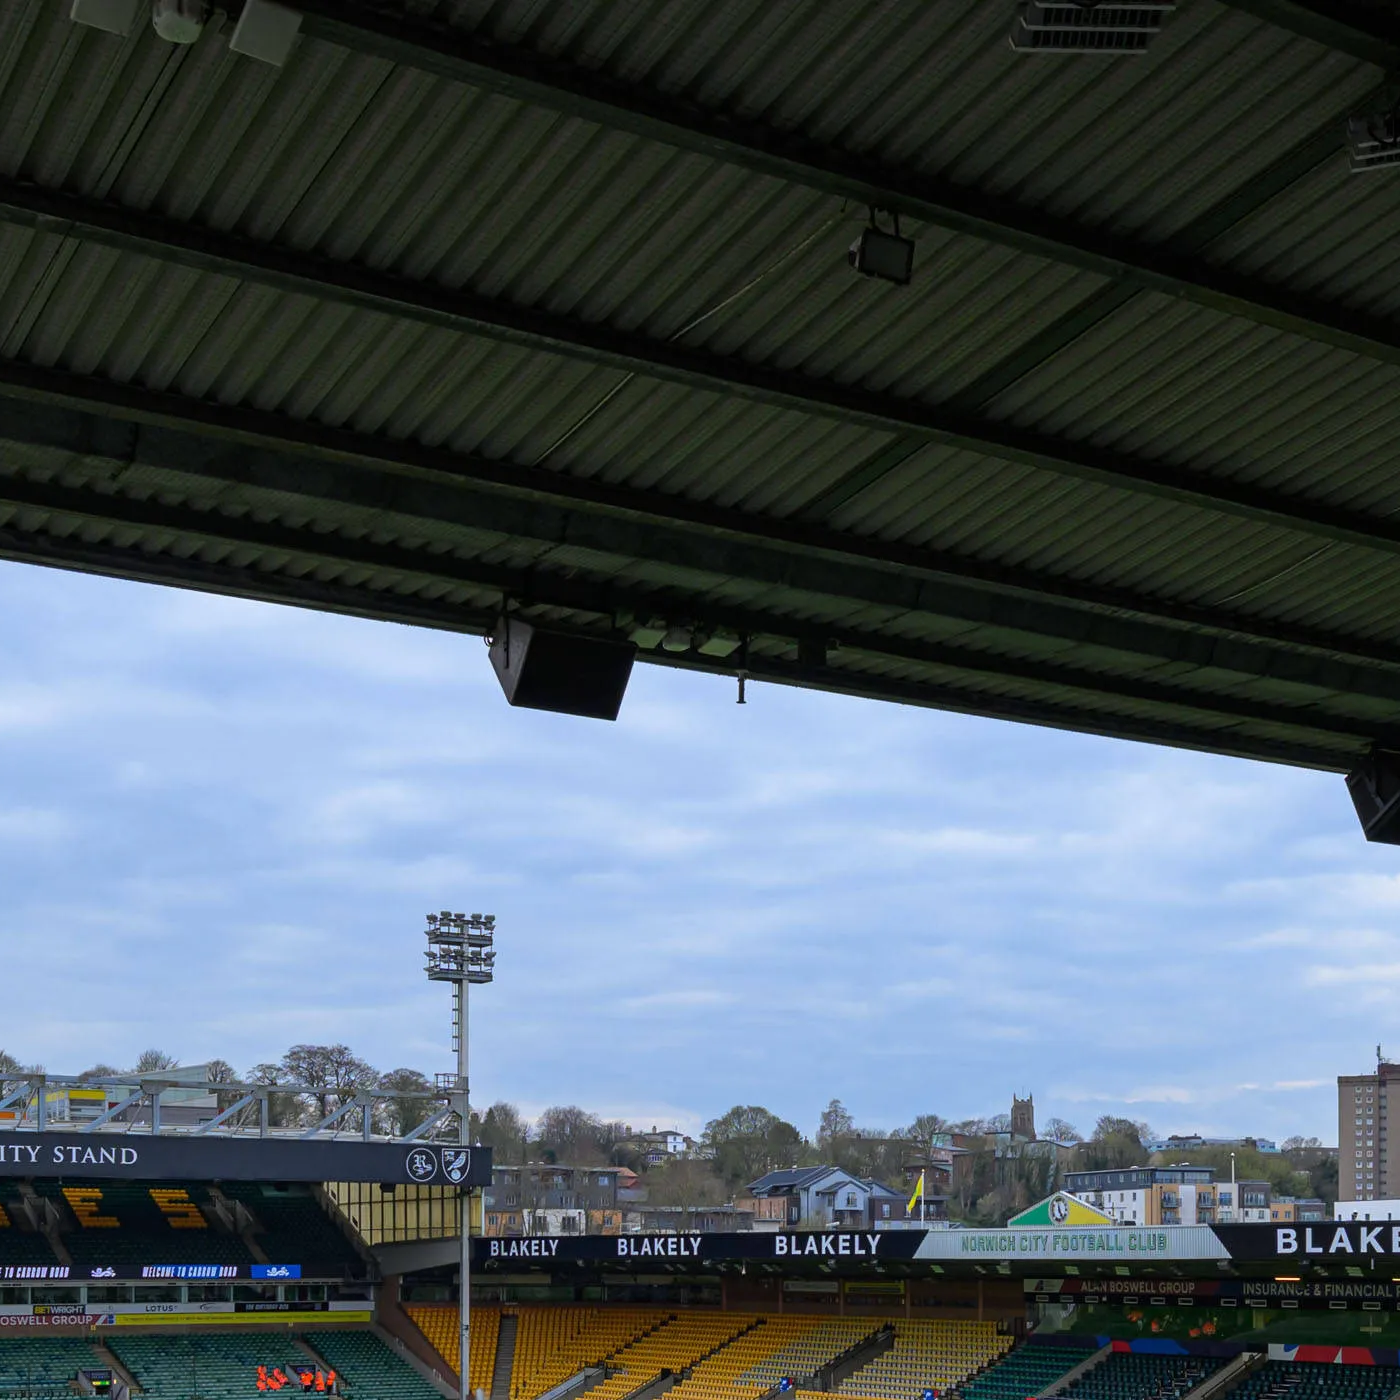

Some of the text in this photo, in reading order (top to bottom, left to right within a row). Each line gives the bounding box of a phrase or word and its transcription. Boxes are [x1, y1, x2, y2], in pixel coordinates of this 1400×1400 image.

[51, 1146, 138, 1165] STAND
[490, 1239, 559, 1257] BLAKELY
[617, 1237, 702, 1256] BLAKELY
[774, 1234, 881, 1255] BLAKELY
[961, 1233, 1167, 1252] NORWICH CITY FOOTBALL CLUB
[4, 1266, 15, 1279] TO
[16, 1266, 48, 1279] CARROW
[48, 1266, 70, 1279] ROAD
[142, 1266, 238, 1278] WELCOME TO CARROW ROAD
[1080, 1281, 1196, 1295] ALAN BOSWELL GROUP
[1243, 1283, 1311, 1296] INSURANCE
[1314, 1284, 1322, 1296] &
[1324, 1283, 1393, 1297] FINANCIAL
[34, 1305, 84, 1314] BETWRIGHT
[52, 1315, 93, 1325] GROUP
